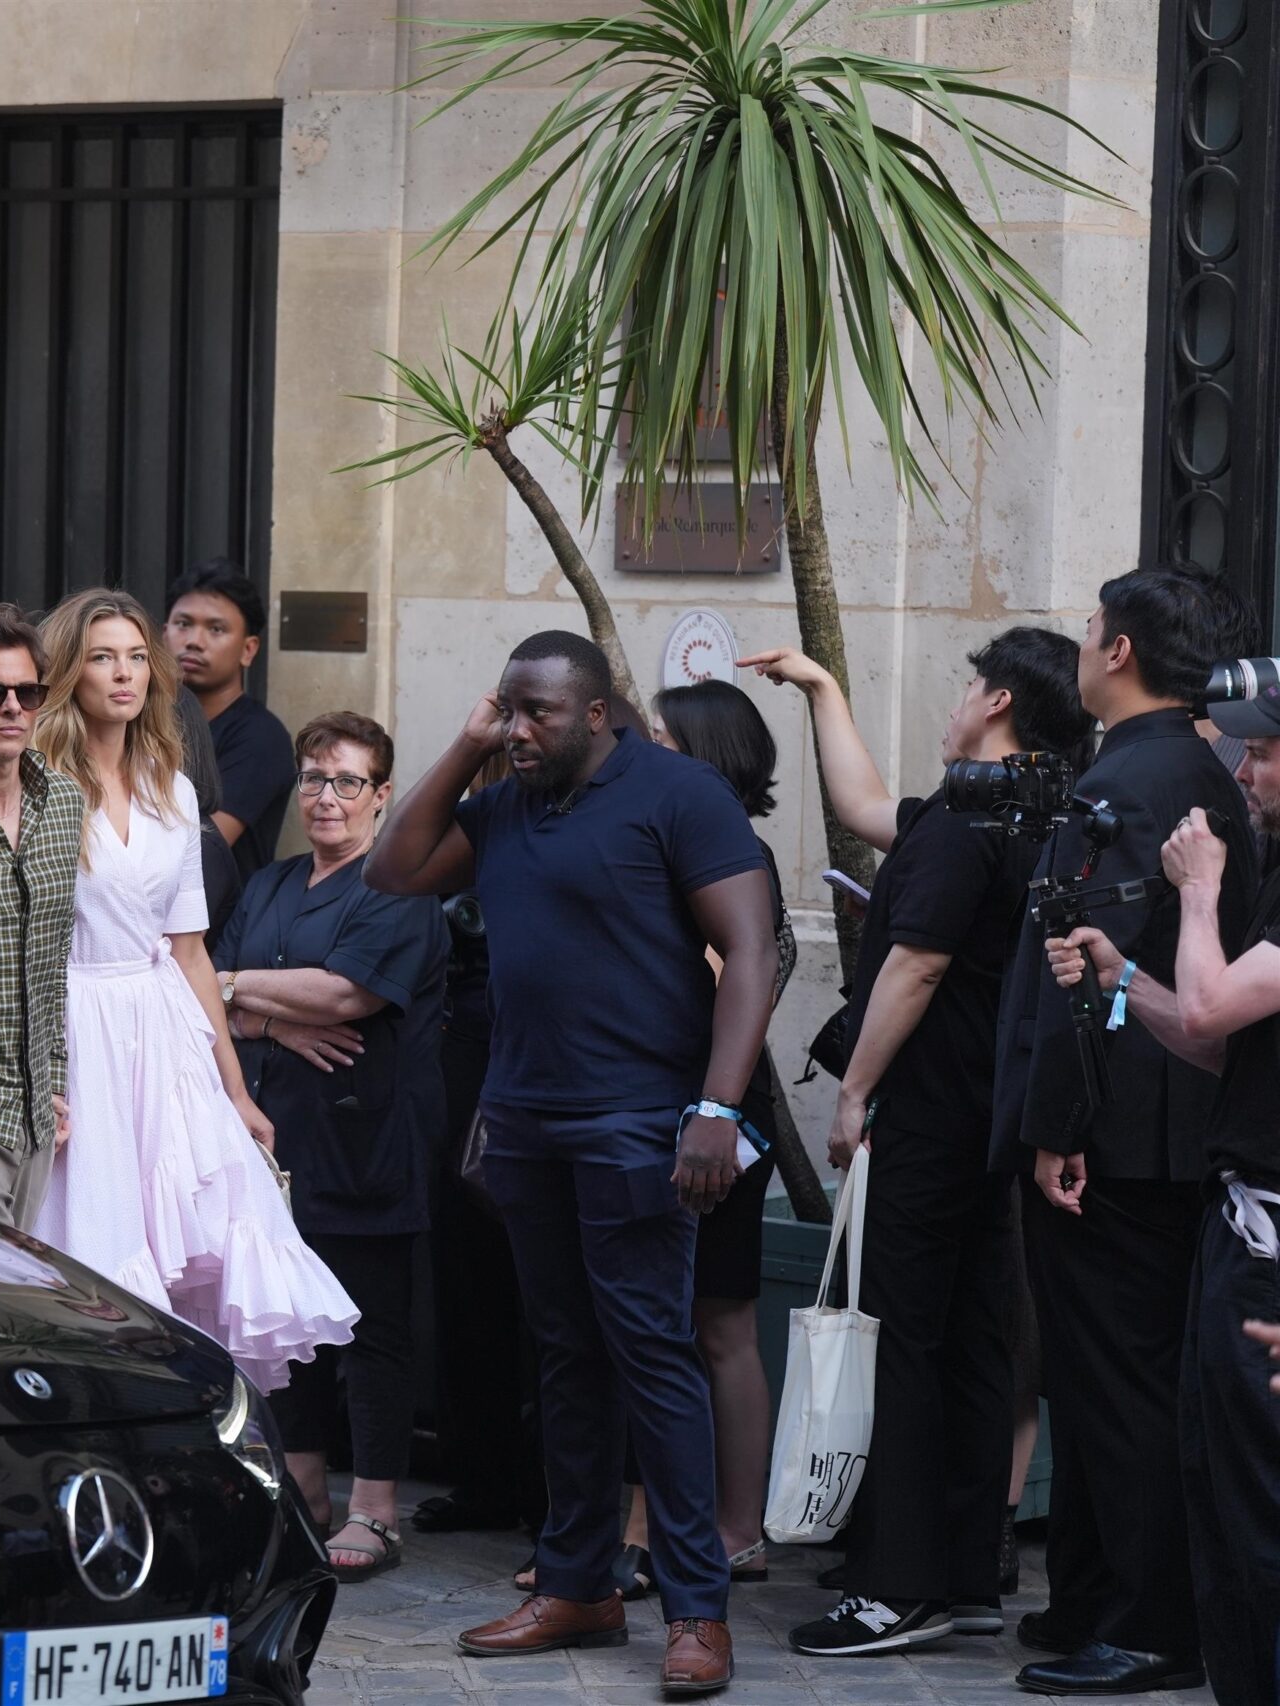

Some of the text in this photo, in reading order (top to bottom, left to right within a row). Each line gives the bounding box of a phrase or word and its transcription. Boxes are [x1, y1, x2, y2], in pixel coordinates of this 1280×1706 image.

[674, 517, 759, 537] Remarqule
[209, 1658, 226, 1686] 78
[8, 1680, 19, 1699] F
